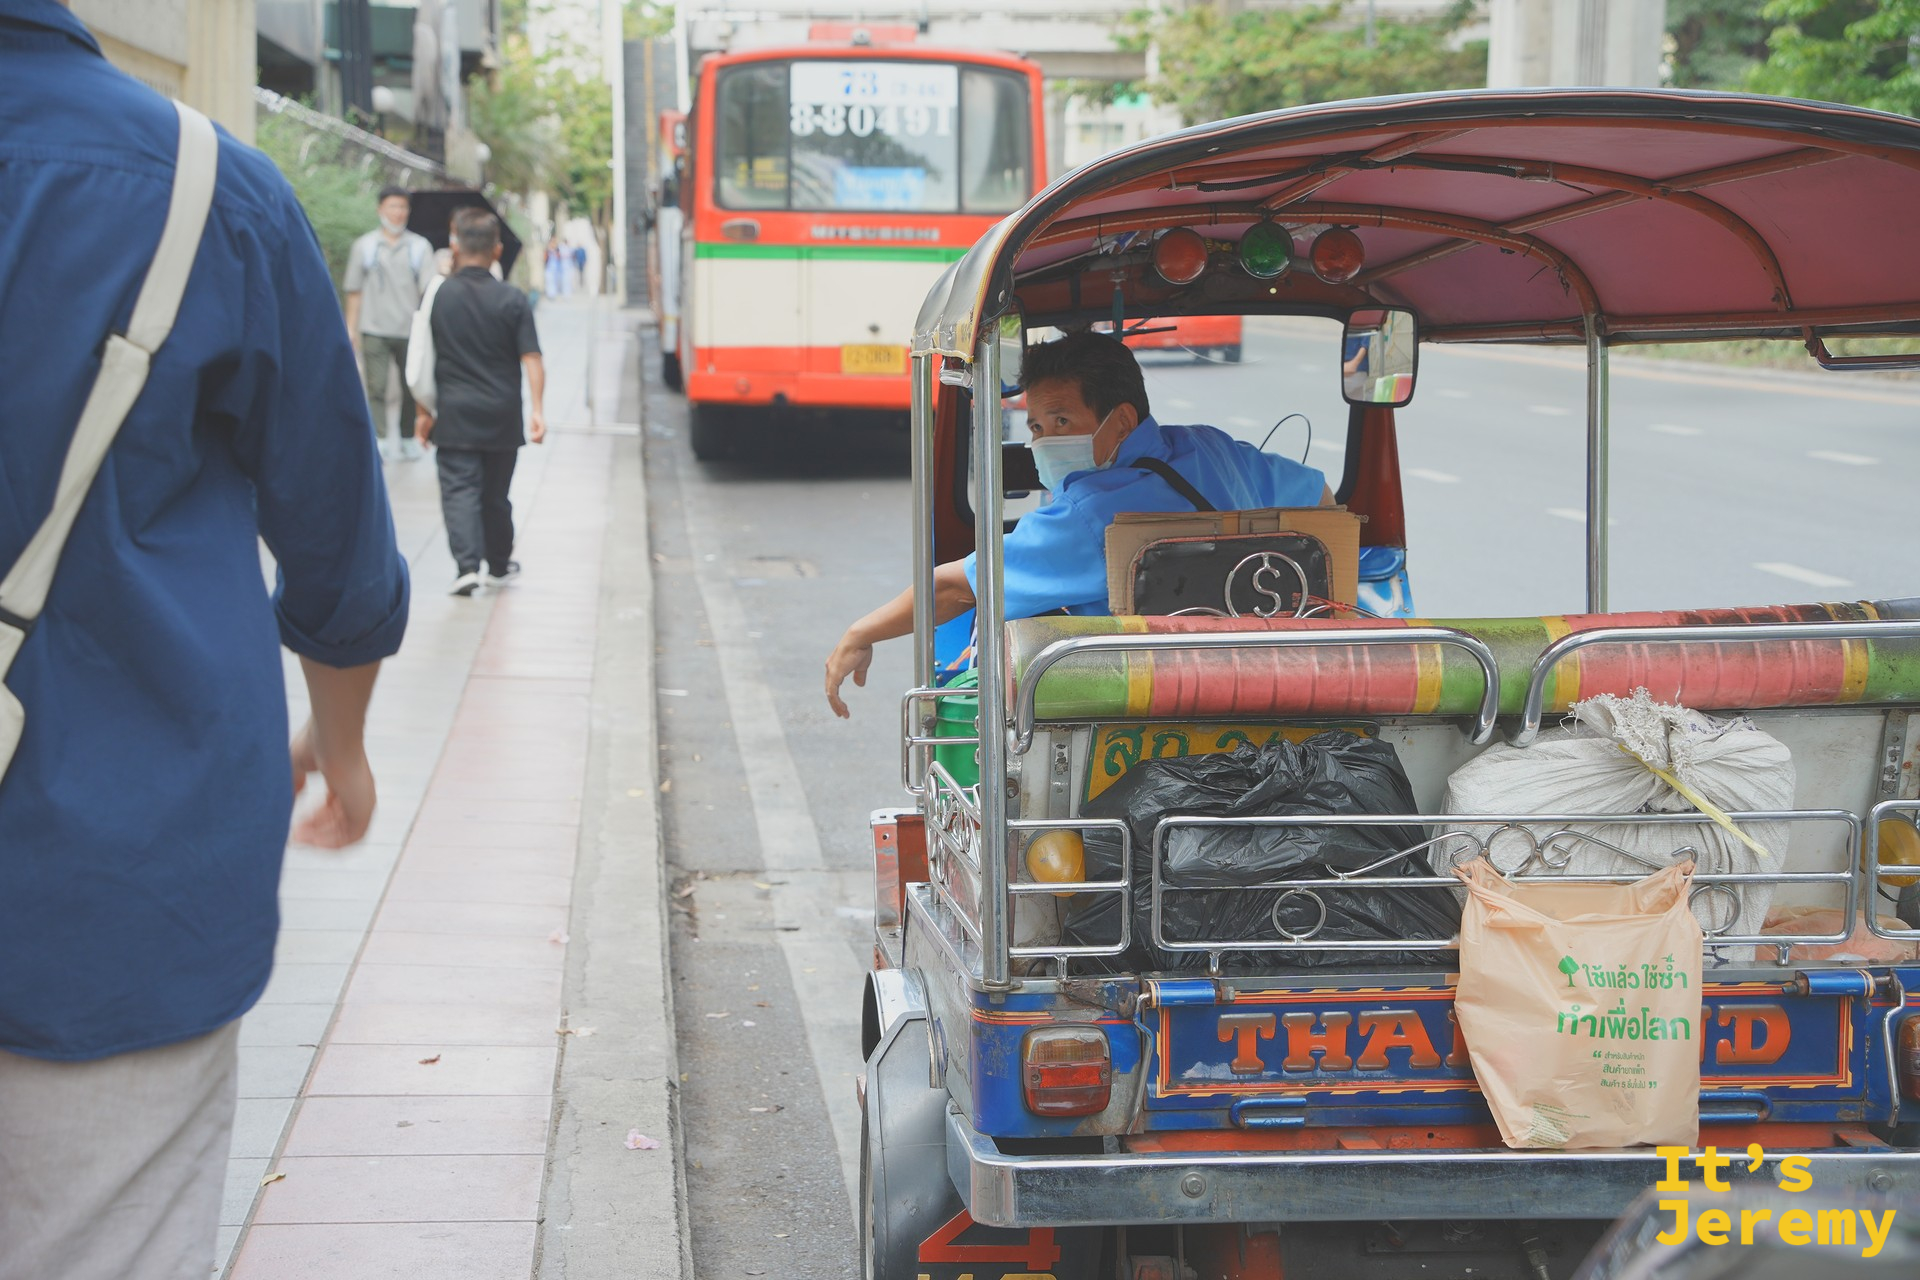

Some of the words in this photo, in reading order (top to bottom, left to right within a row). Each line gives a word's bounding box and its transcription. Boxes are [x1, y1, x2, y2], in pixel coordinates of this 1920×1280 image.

[1582, 963, 1641, 989] ใช้แล้ว
[1557, 997, 1690, 1041] ทำเพื่อโลก
